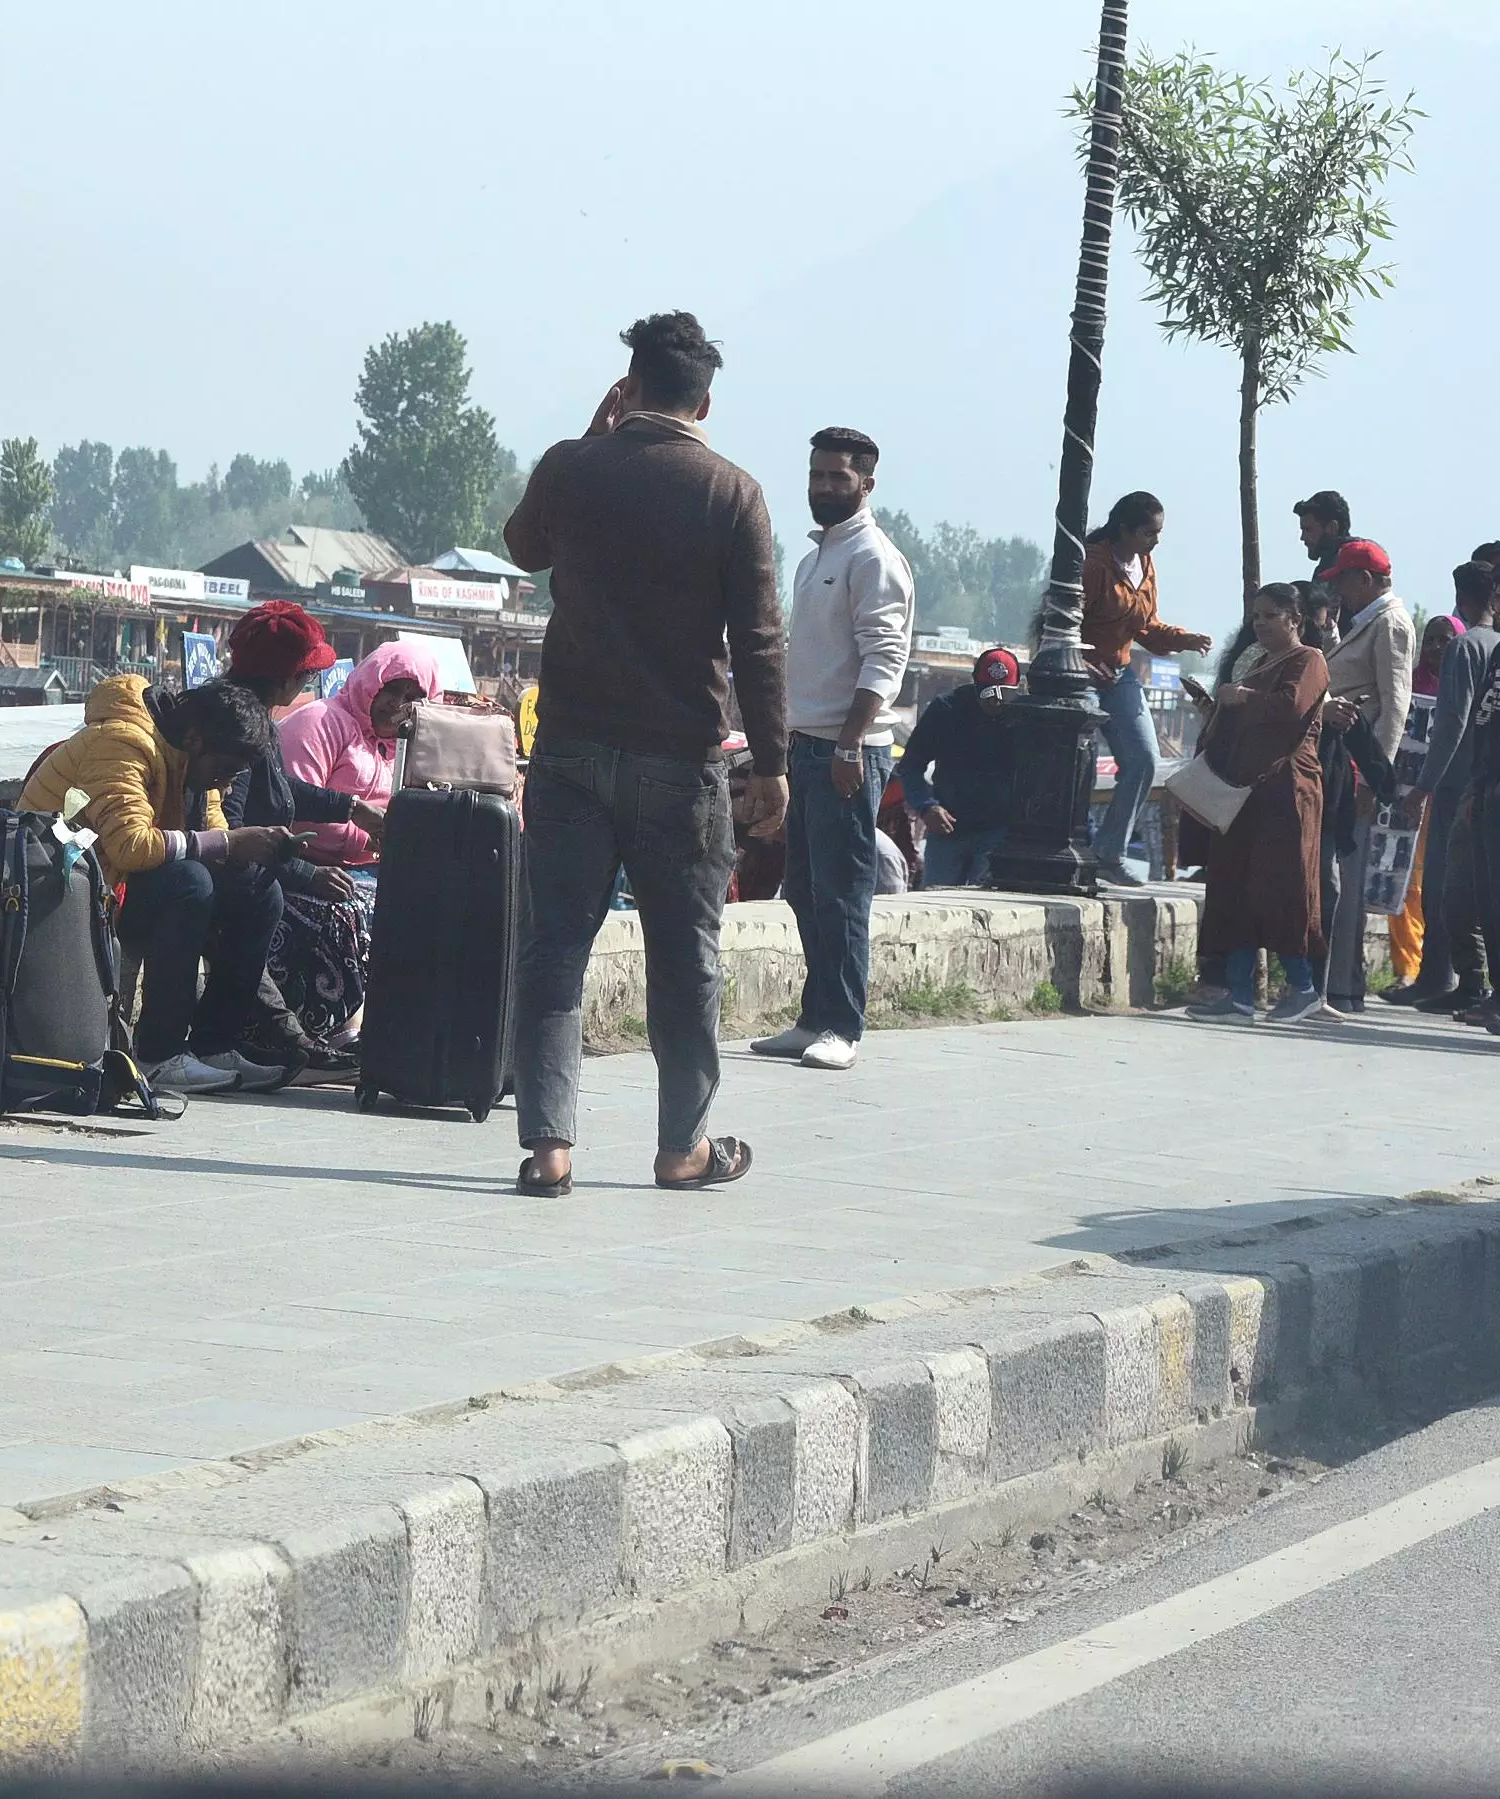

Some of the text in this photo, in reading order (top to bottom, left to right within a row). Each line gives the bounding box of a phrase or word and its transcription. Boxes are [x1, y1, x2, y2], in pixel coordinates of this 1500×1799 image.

[418, 584, 496, 601] KING OF KASHMIR
